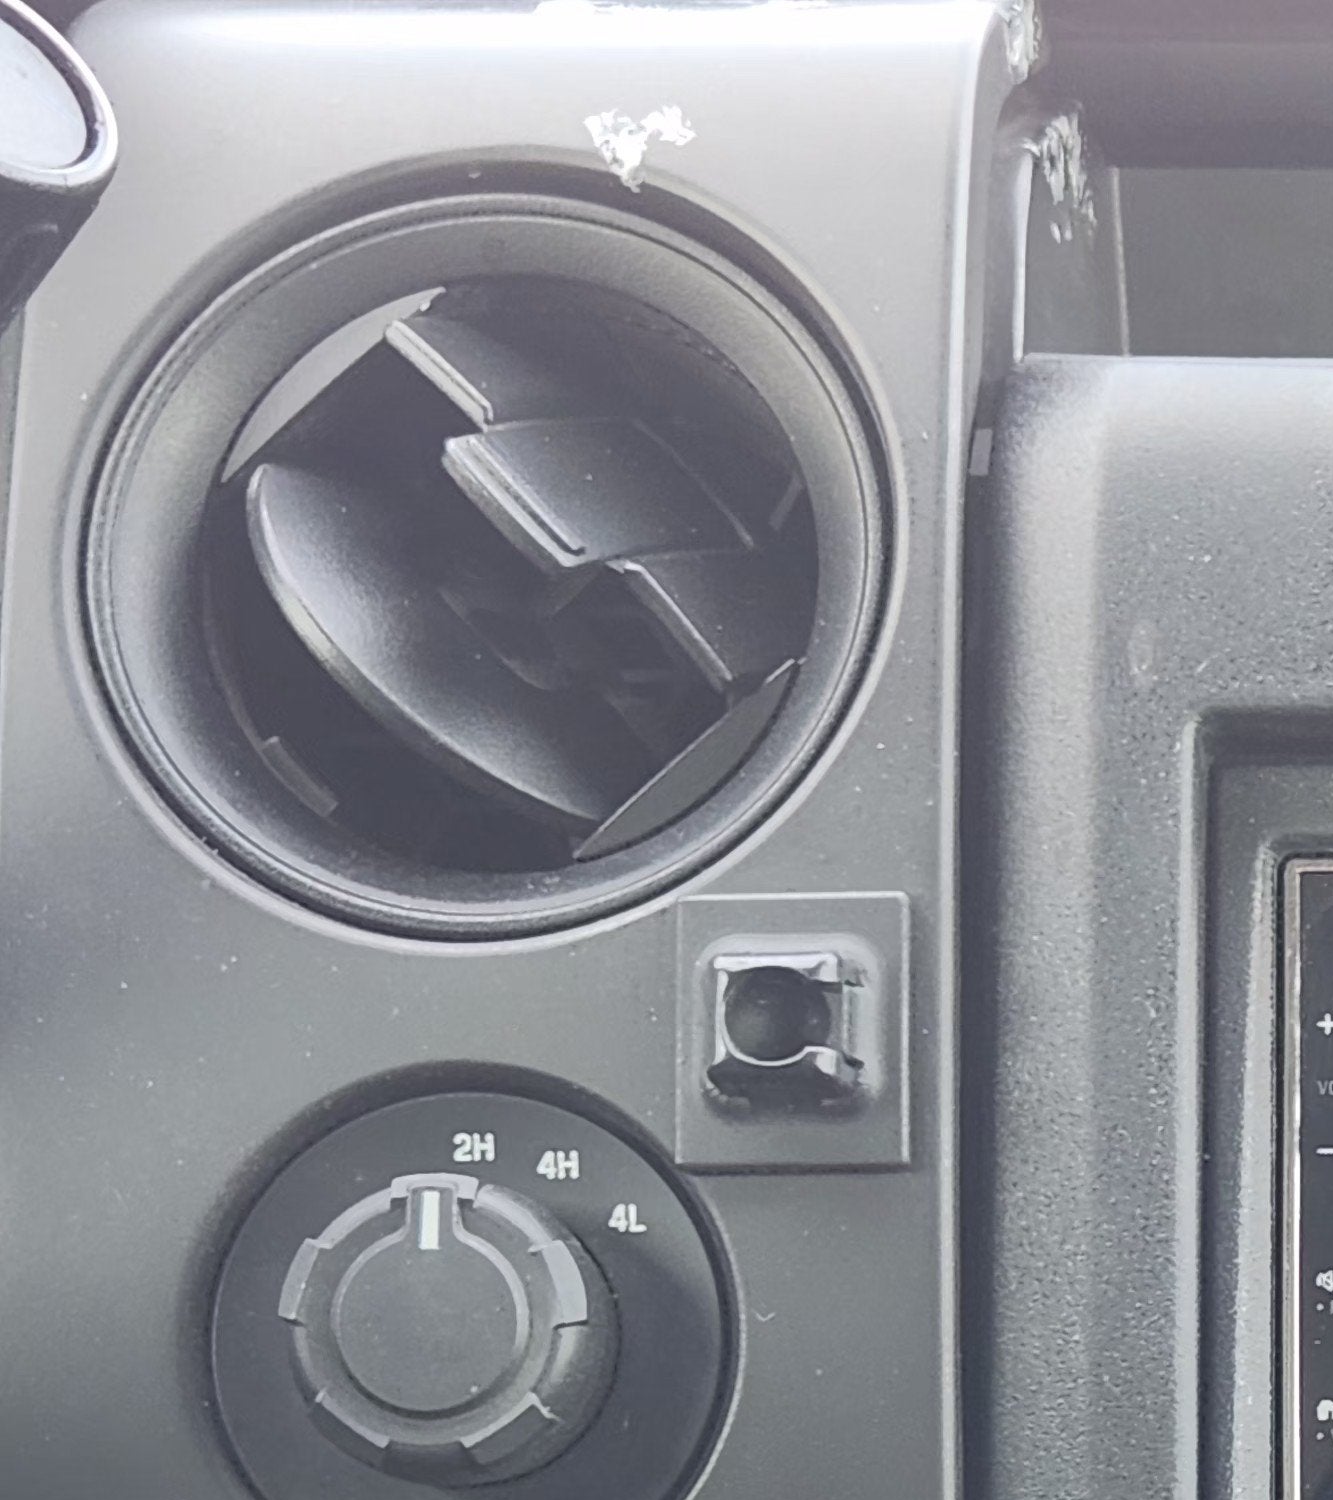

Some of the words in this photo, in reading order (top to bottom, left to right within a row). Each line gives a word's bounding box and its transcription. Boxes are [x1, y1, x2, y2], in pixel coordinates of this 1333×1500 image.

[452, 1133, 496, 1162] 2H
[536, 1150, 580, 1180] 4H
[608, 1203, 648, 1233] 4L
